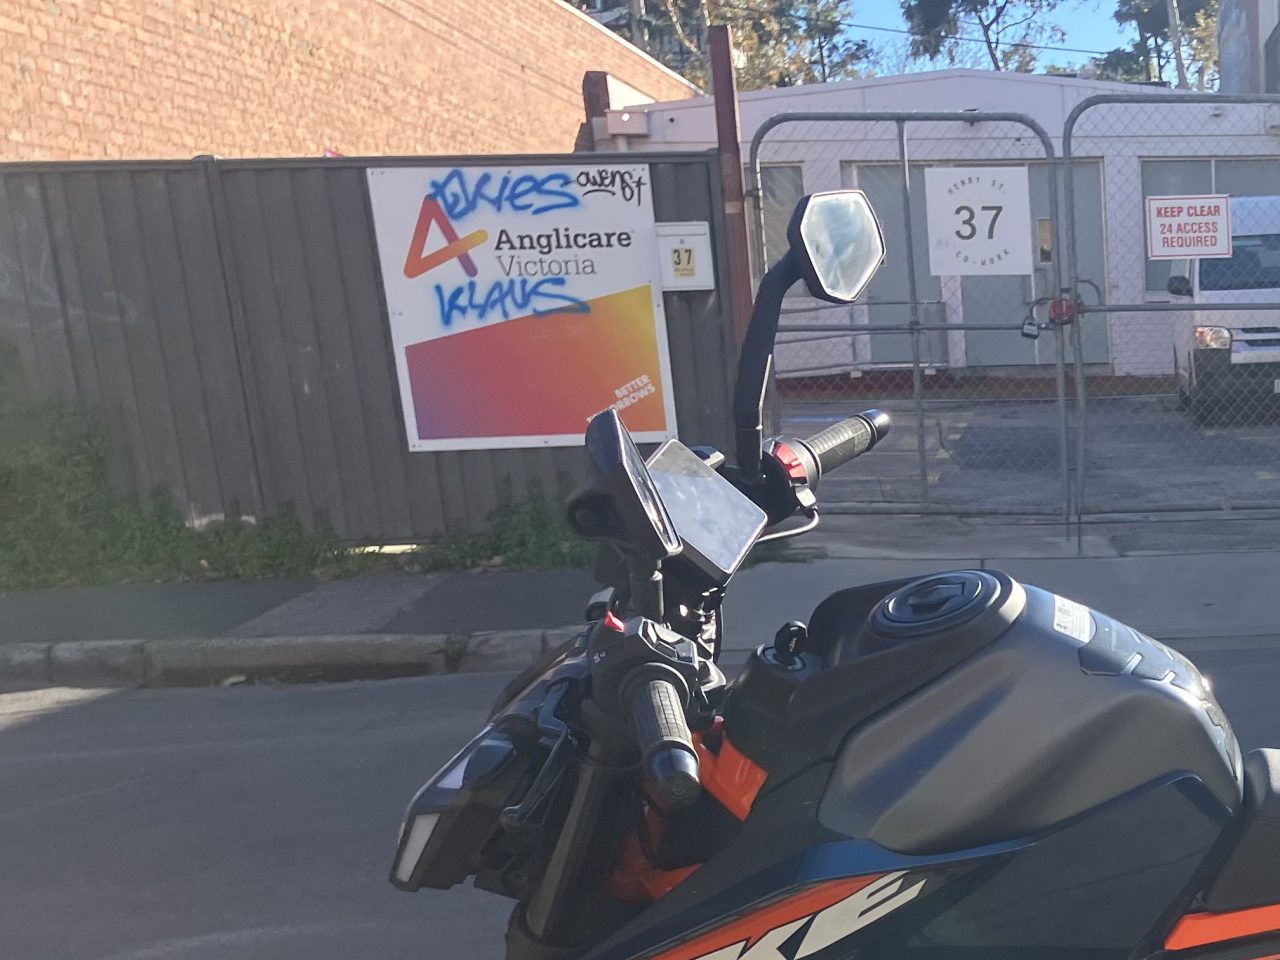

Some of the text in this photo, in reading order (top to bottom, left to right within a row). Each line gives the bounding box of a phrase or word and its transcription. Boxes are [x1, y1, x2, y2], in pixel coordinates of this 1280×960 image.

[1156, 205, 1221, 218] KEEP CLEAR
[954, 205, 1004, 241] 37
[1160, 222, 1218, 235] 24 ACCESS
[494, 227, 632, 254] Anglicare
[1162, 235, 1218, 248] REQUIRED
[495, 254, 597, 277] Victoria
[673, 248, 692, 266] 37
[614, 374, 651, 399] BETTER
